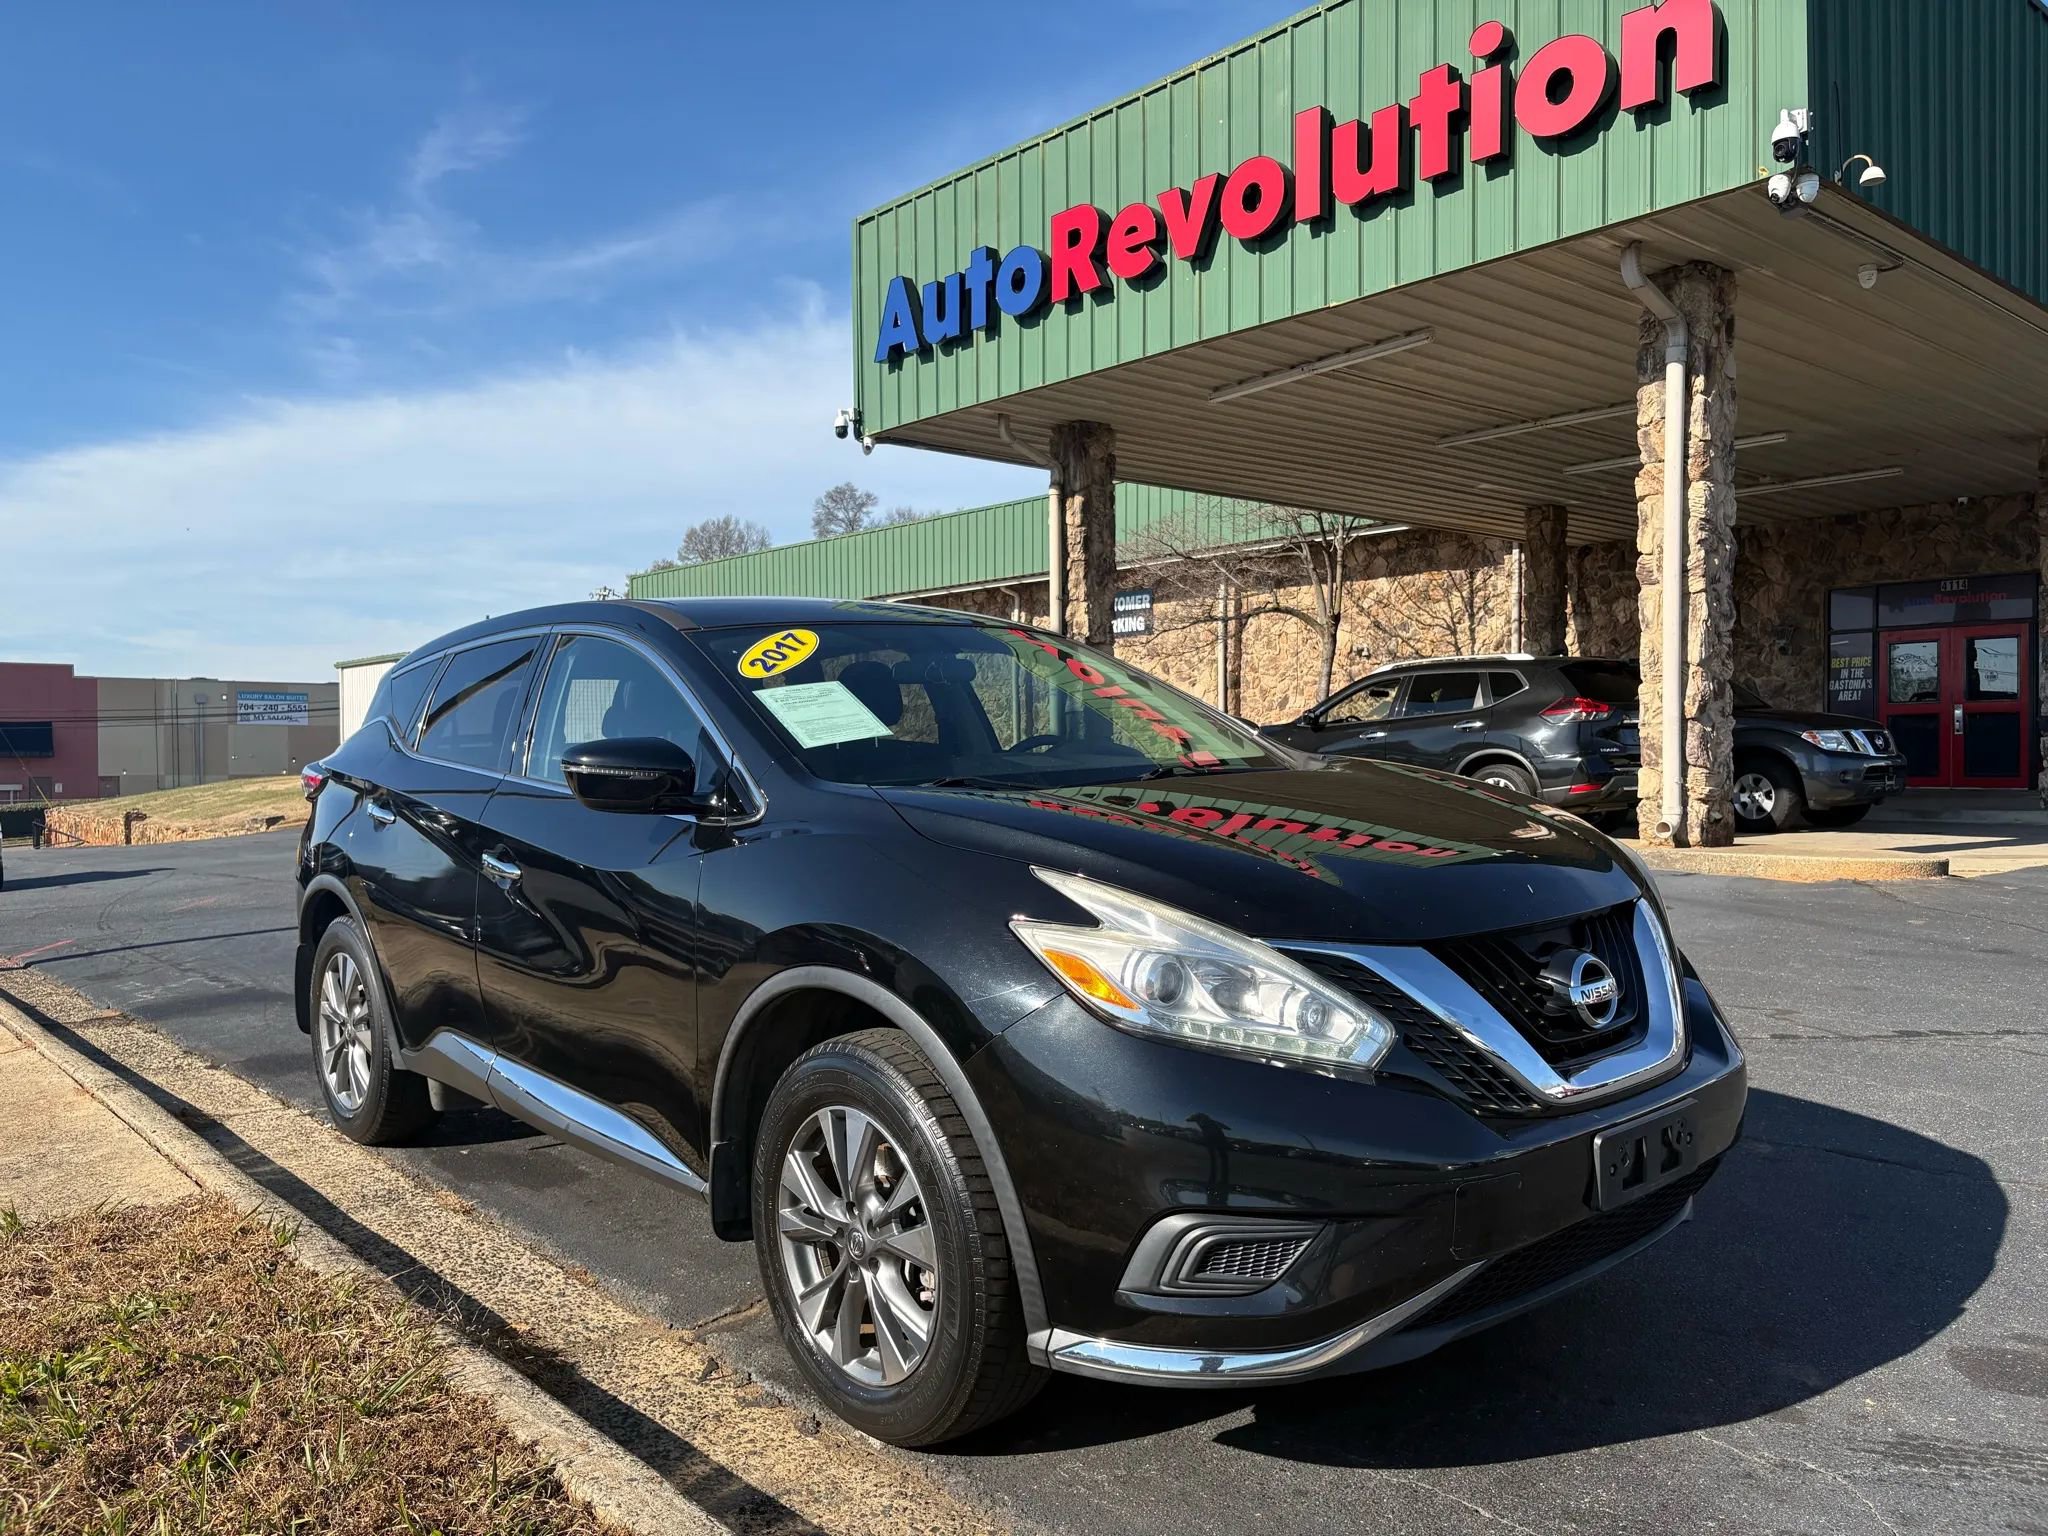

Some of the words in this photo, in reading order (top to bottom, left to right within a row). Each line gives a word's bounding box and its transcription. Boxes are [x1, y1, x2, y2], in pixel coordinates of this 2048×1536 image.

[874, 0, 1717, 363] AutoRevolution
[1114, 594, 1151, 612] TOMER
[1111, 616, 1145, 633] RKING
[748, 632, 807, 673] 2017
[1831, 657, 1850, 669] BEST
[1850, 656, 1872, 668] PRICE
[1840, 668, 1849, 679] IN
[1850, 667, 1865, 678] THE
[1837, 690, 1862, 702] AREA!
[239, 703, 254, 711] 704
[262, 703, 279, 711] 240
